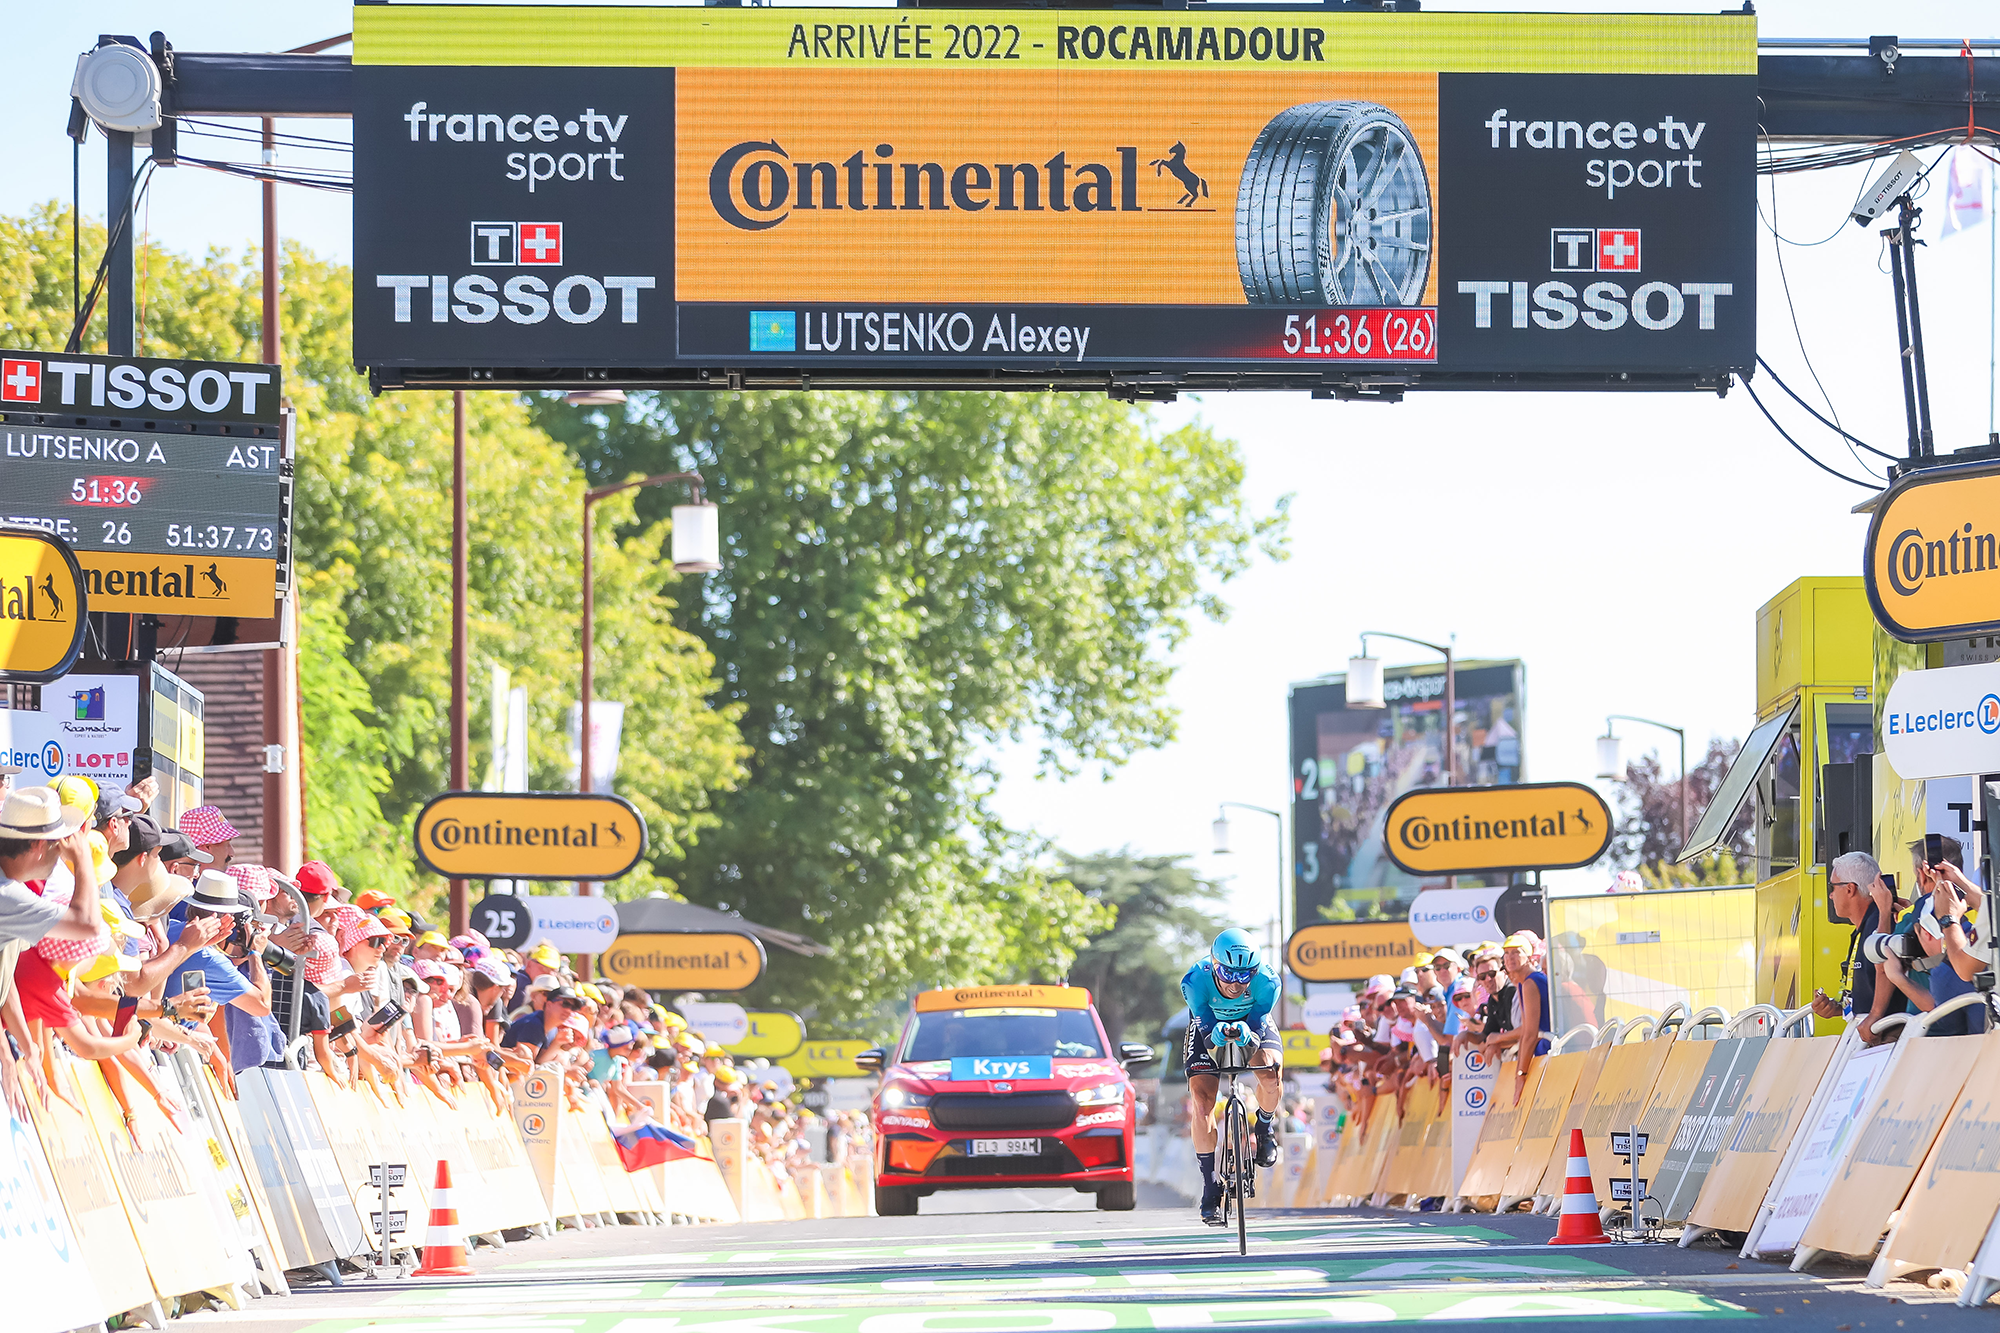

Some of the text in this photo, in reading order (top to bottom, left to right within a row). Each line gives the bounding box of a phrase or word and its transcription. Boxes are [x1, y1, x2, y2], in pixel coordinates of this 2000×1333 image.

[787, 16, 932, 59] ARRIVÉE
[943, 24, 1021, 59] 2022
[1058, 25, 1325, 62] ROCAMADOUR
[506, 147, 624, 192] sport
[709, 138, 1141, 231] Continental
[1585, 155, 1701, 199] sport
[1882, 170, 1904, 195] TISSOT
[376, 275, 655, 325] TISSOT
[1458, 281, 1732, 331] TISSOT
[804, 312, 1090, 362] LUTSENKO Alexey
[1282, 312, 1435, 356] 51:36 (26)
[48, 361, 270, 414] TISSOT
[7, 433, 166, 464] LUTSENKO A
[226, 446, 275, 469] AST
[71, 478, 141, 504] 51:36
[102, 521, 132, 545] 26
[166, 524, 273, 550] 51:37.73
[1887, 522, 2000, 597] Contin
[82, 565, 195, 598] nental
[1889, 709, 1974, 735] E.Leclerc
[76, 753, 115, 768] LOT
[1301, 757, 1319, 800] 2
[430, 818, 597, 851] Continental
[1400, 810, 1565, 850] Continental
[1302, 842, 1319, 884] 3
[484, 910, 516, 939] 25
[609, 949, 730, 975] Continental
[1296, 938, 1415, 966] Continental
[954, 988, 1033, 1002] Continental
[1286, 1035, 1314, 1050] CL
[974, 1058, 1030, 1080] Krys
[977, 1141, 998, 1153] EL3
[375, 1220, 405, 1228] TISOT
